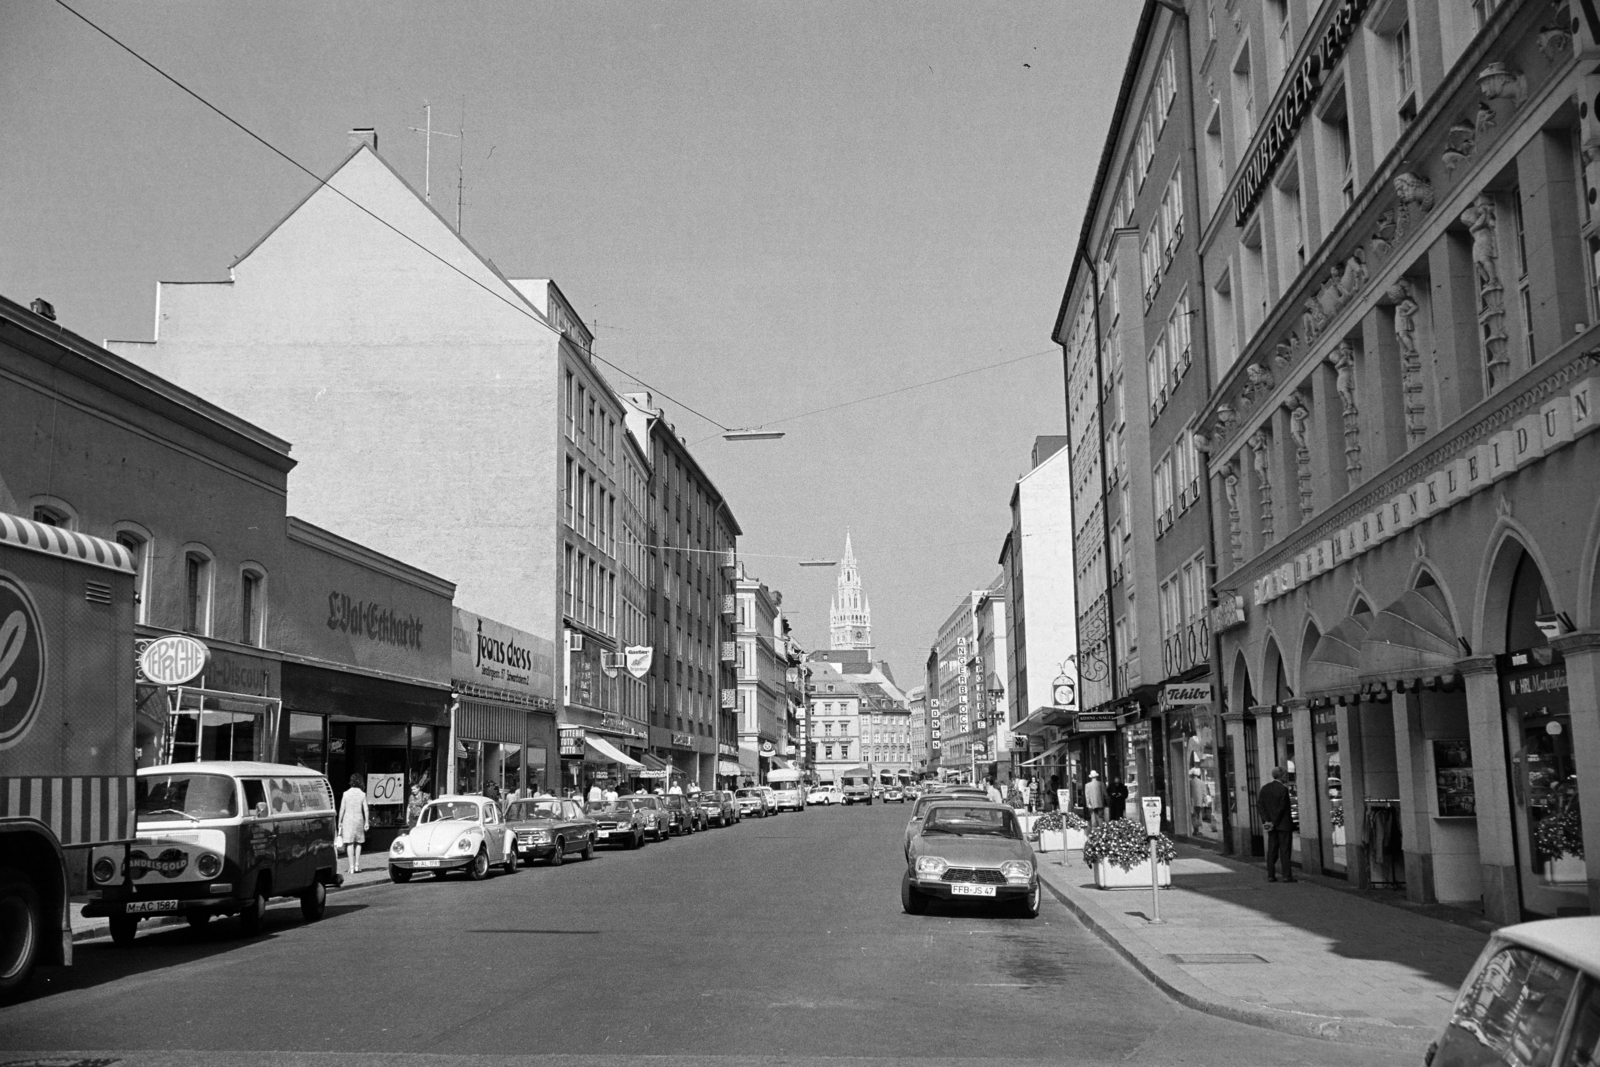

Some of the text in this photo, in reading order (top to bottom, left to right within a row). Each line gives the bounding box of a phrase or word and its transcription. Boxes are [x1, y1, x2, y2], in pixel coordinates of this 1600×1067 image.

[1295, 548, 1325, 578] DER
[506, 634, 532, 671] dress
[144, 639, 202, 682] TEPPICHE
[958, 638, 967, 732] ANGERBLOCK
[975, 657, 985, 728] APOTHEKE
[1167, 687, 1211, 701] Tchibo
[559, 729, 585, 739] LOTTERIE
[560, 737, 574, 747] TOTO
[559, 746, 576, 755] LOTTO
[122, 859, 188, 871] ANDELSGOLD
[953, 886, 994, 895] FFB-JS 47
[128, 901, 177, 912] M-AC 1582
